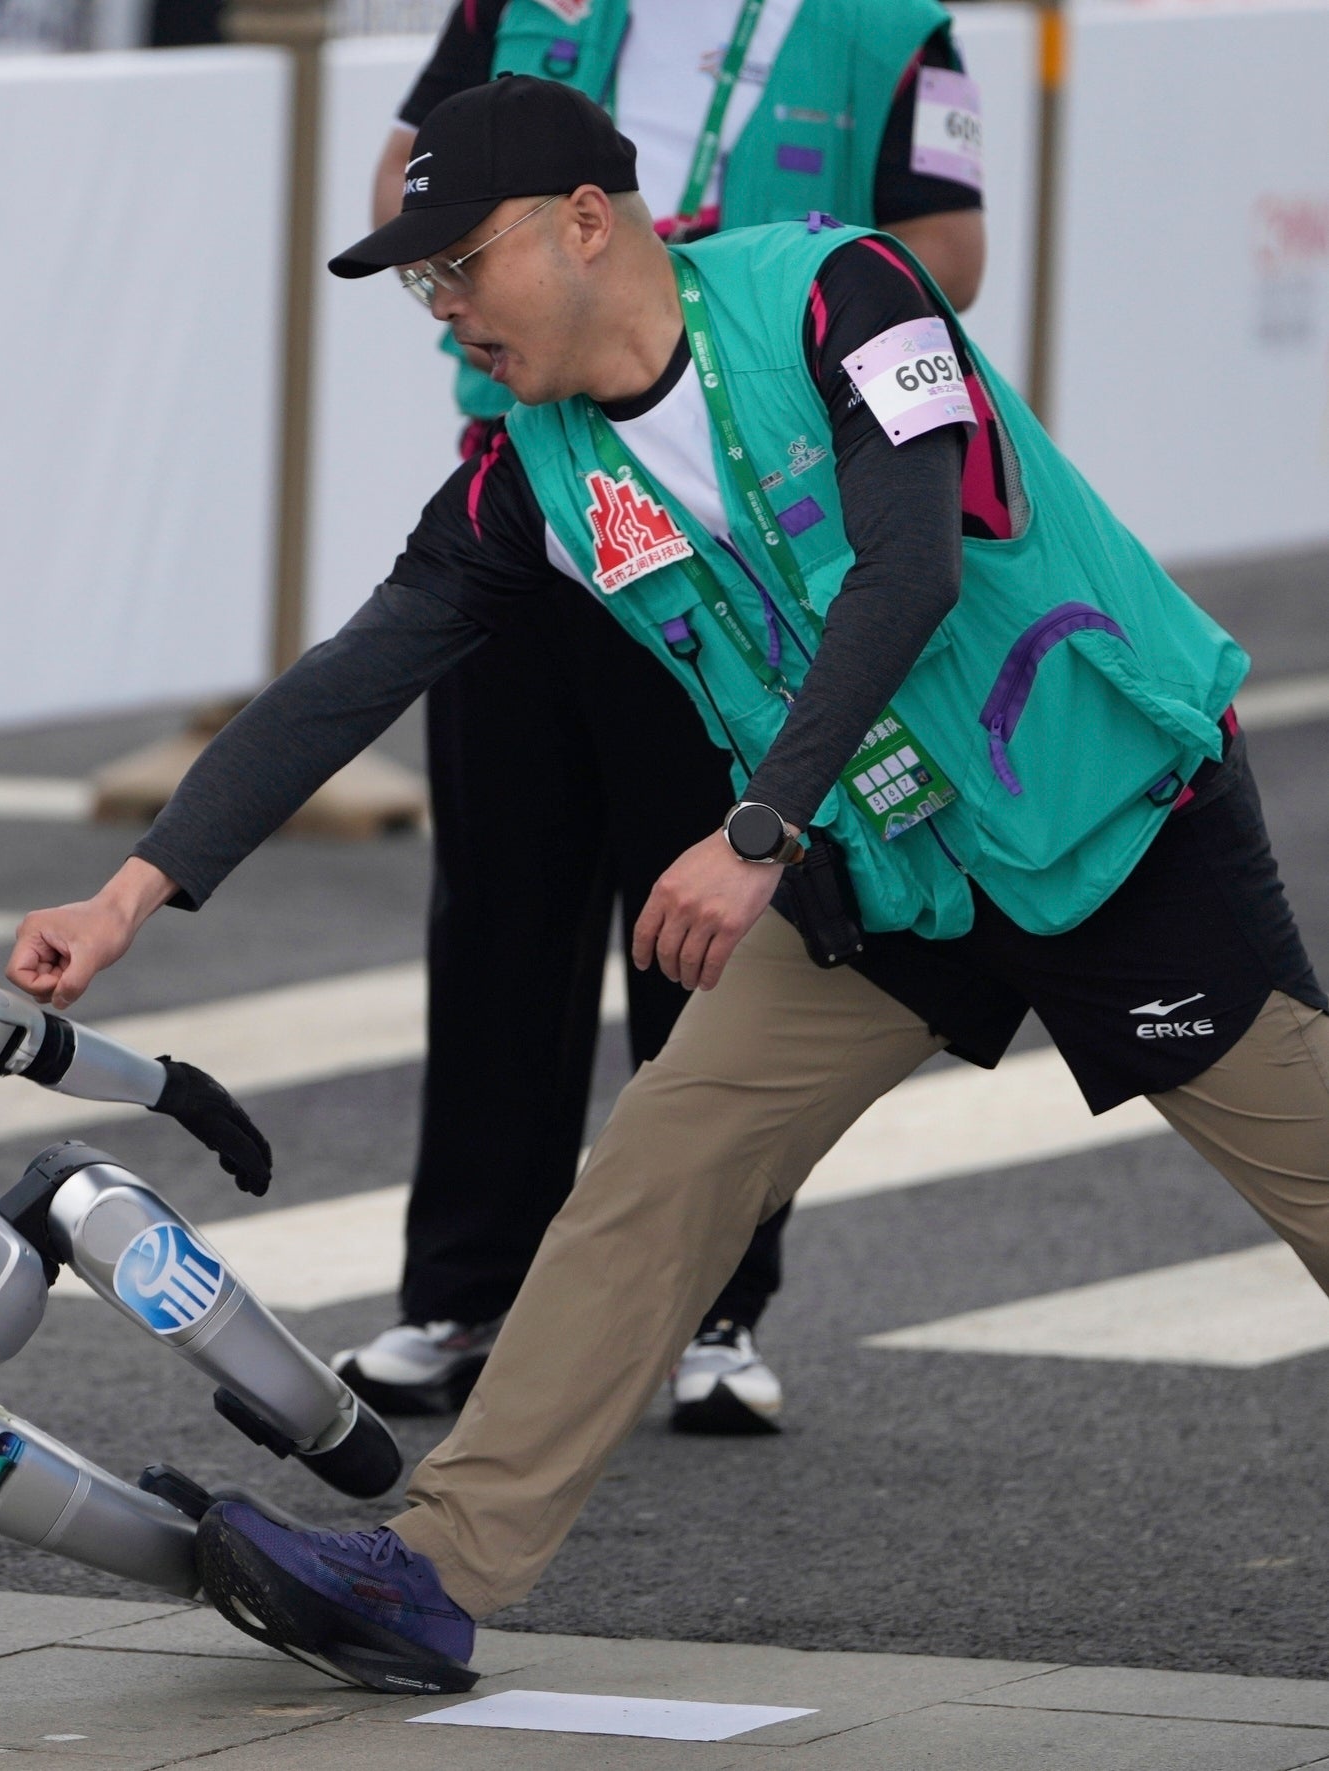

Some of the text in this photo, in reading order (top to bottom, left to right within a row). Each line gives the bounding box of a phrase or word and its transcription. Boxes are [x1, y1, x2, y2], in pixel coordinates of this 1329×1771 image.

[403, 176, 430, 196] KE
[602, 541, 689, 589] 城市之间科技队
[853, 717, 902, 758] 人参赛队
[1136, 1018, 1215, 1039] ERKE
